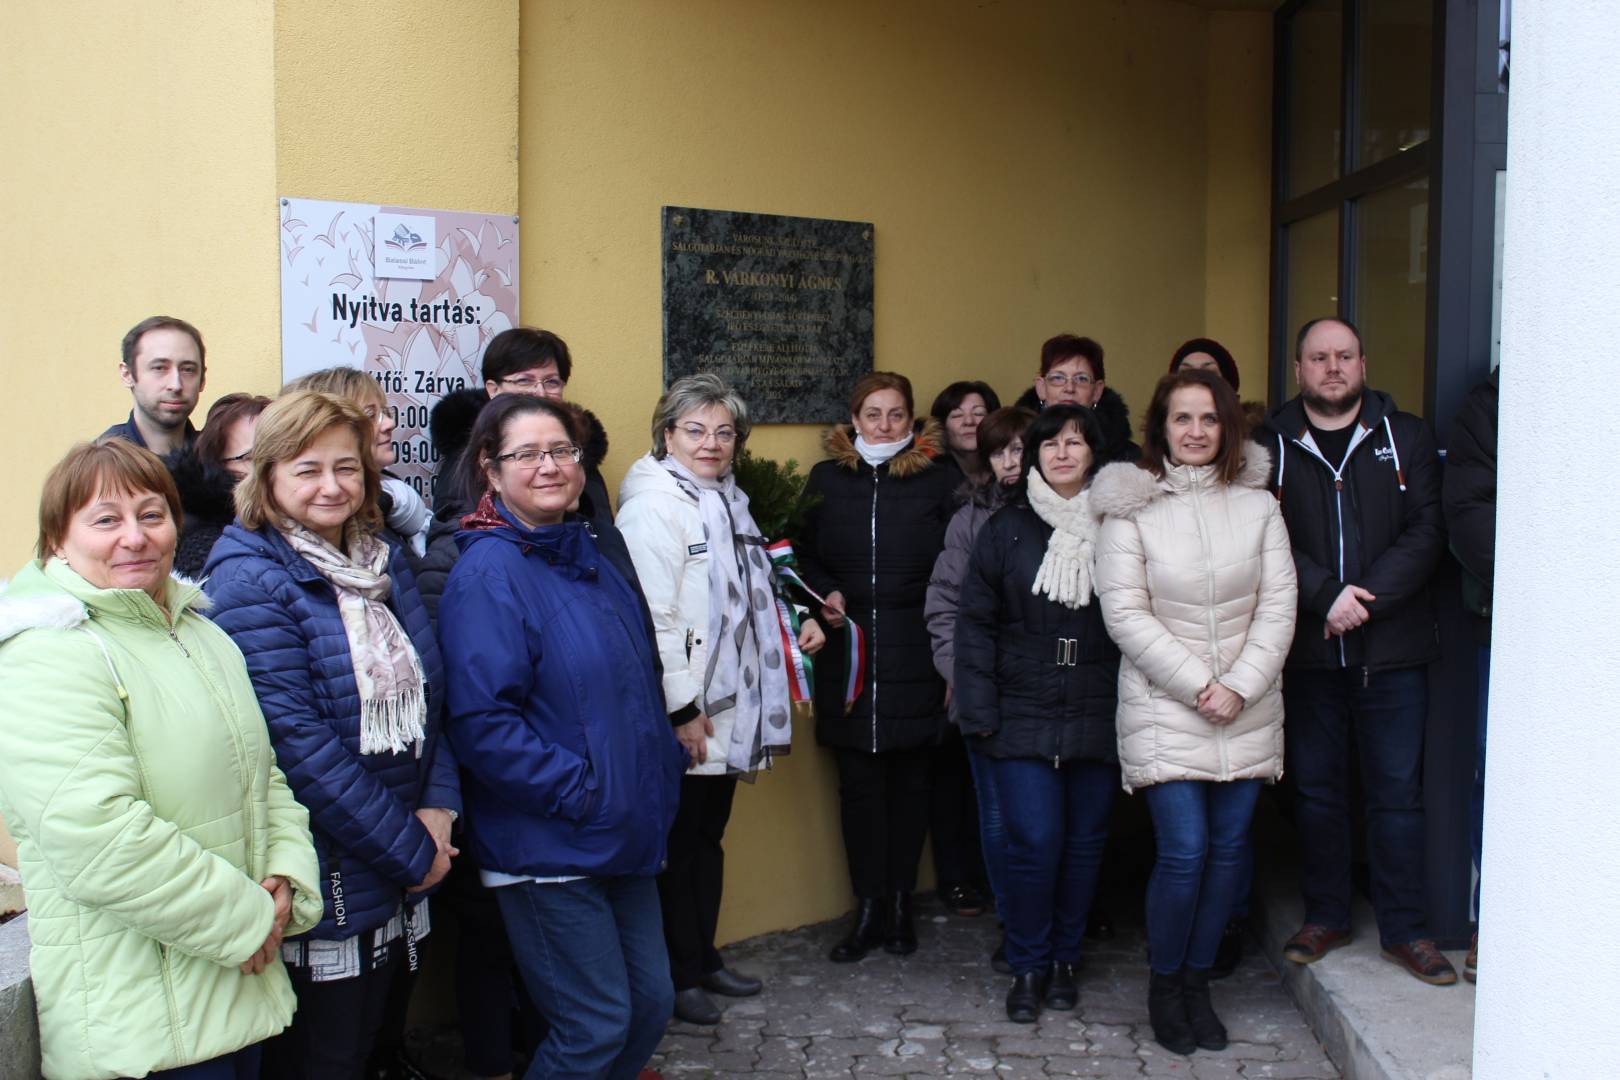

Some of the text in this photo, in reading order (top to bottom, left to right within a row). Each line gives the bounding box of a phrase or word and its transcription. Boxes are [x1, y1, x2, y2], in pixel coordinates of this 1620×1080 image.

[705, 269, 720, 285] R.
[332, 293, 481, 328] Nyitva tartás:
[369, 369, 465, 394] tfő: Zárva
[330, 871, 347, 926] FASHION
